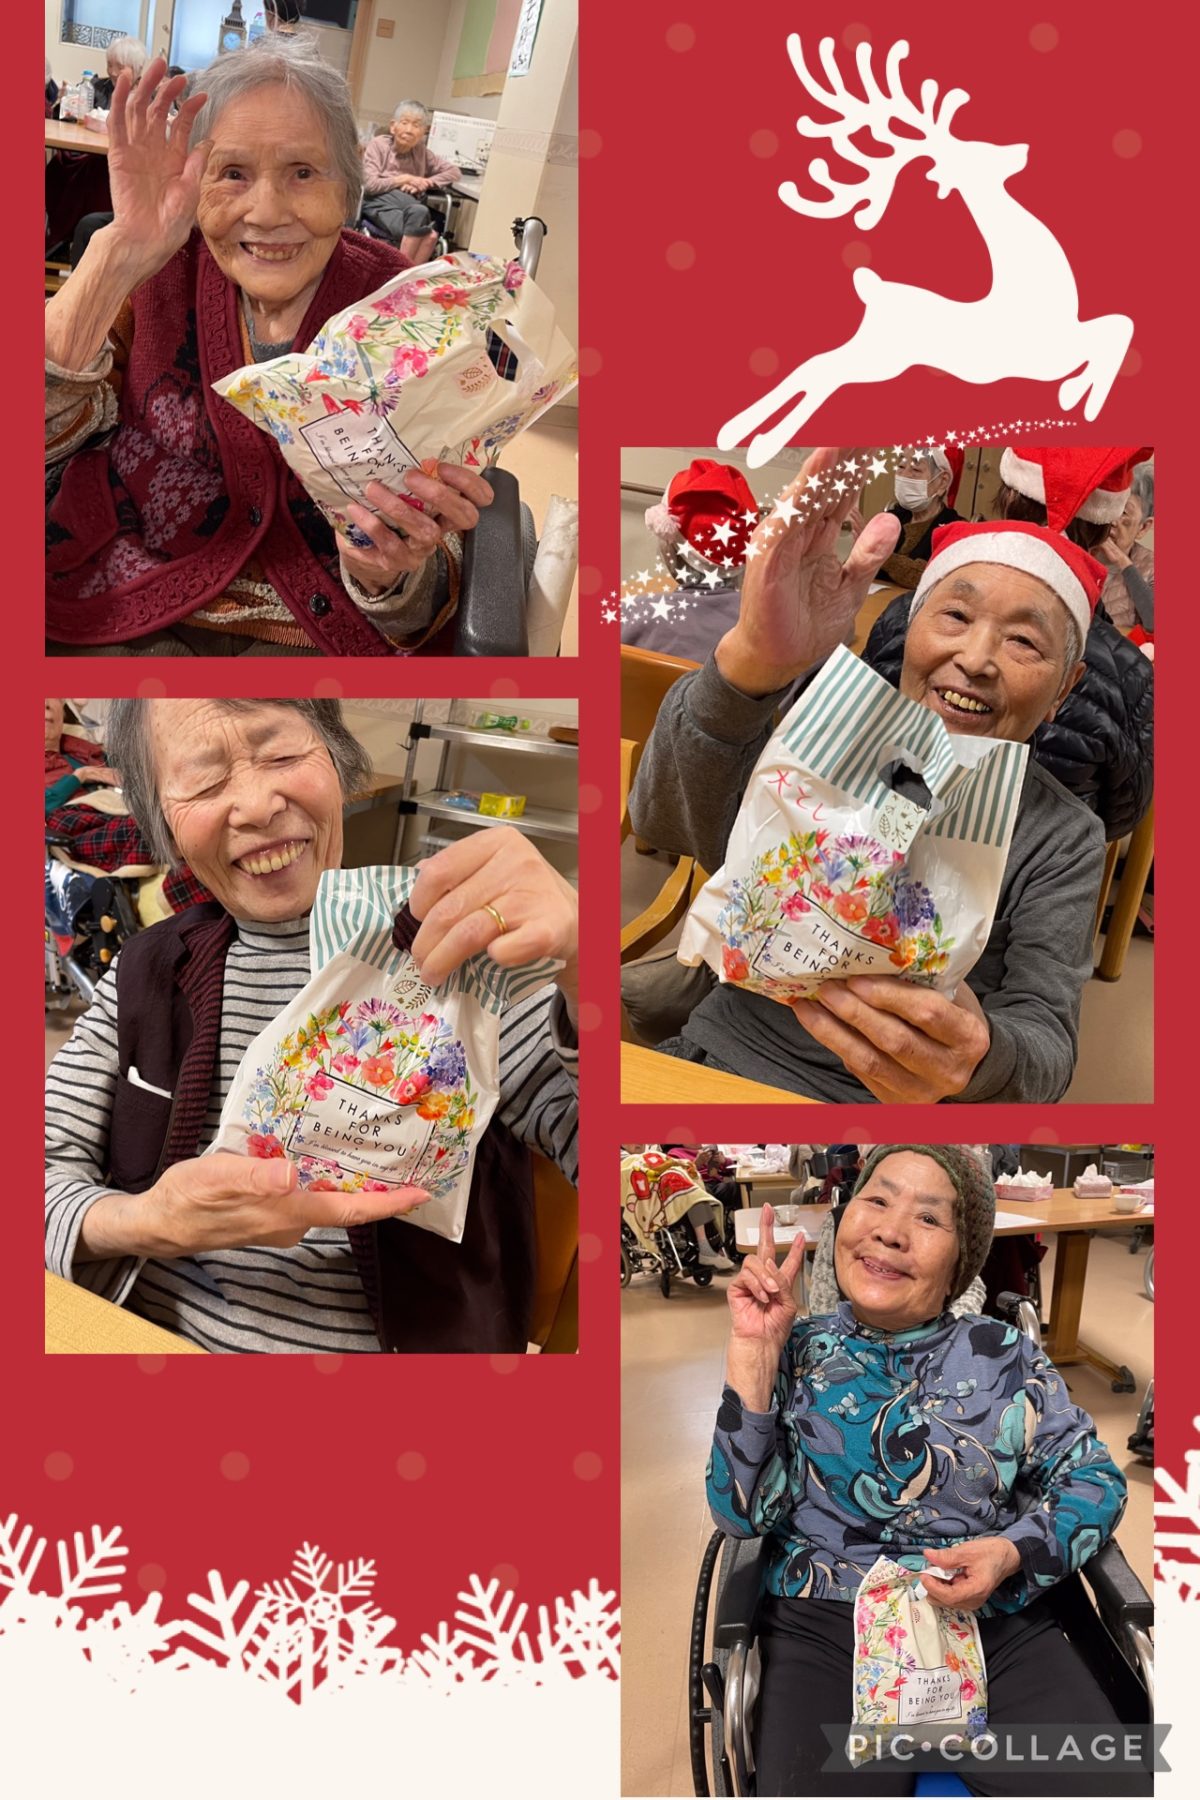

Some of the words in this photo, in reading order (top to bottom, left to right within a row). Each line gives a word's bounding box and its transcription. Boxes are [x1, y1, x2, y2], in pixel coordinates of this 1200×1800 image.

[811, 924, 875, 966] THANKS
[818, 947, 850, 970] FOR
[348, 1121, 381, 1137] FOR
[313, 1122, 364, 1149] BEING
[374, 1141, 407, 1157] YOU
[917, 1674, 951, 1686] THANKS
[927, 1685, 943, 1695] FOR
[908, 1695, 936, 1706] BEING
